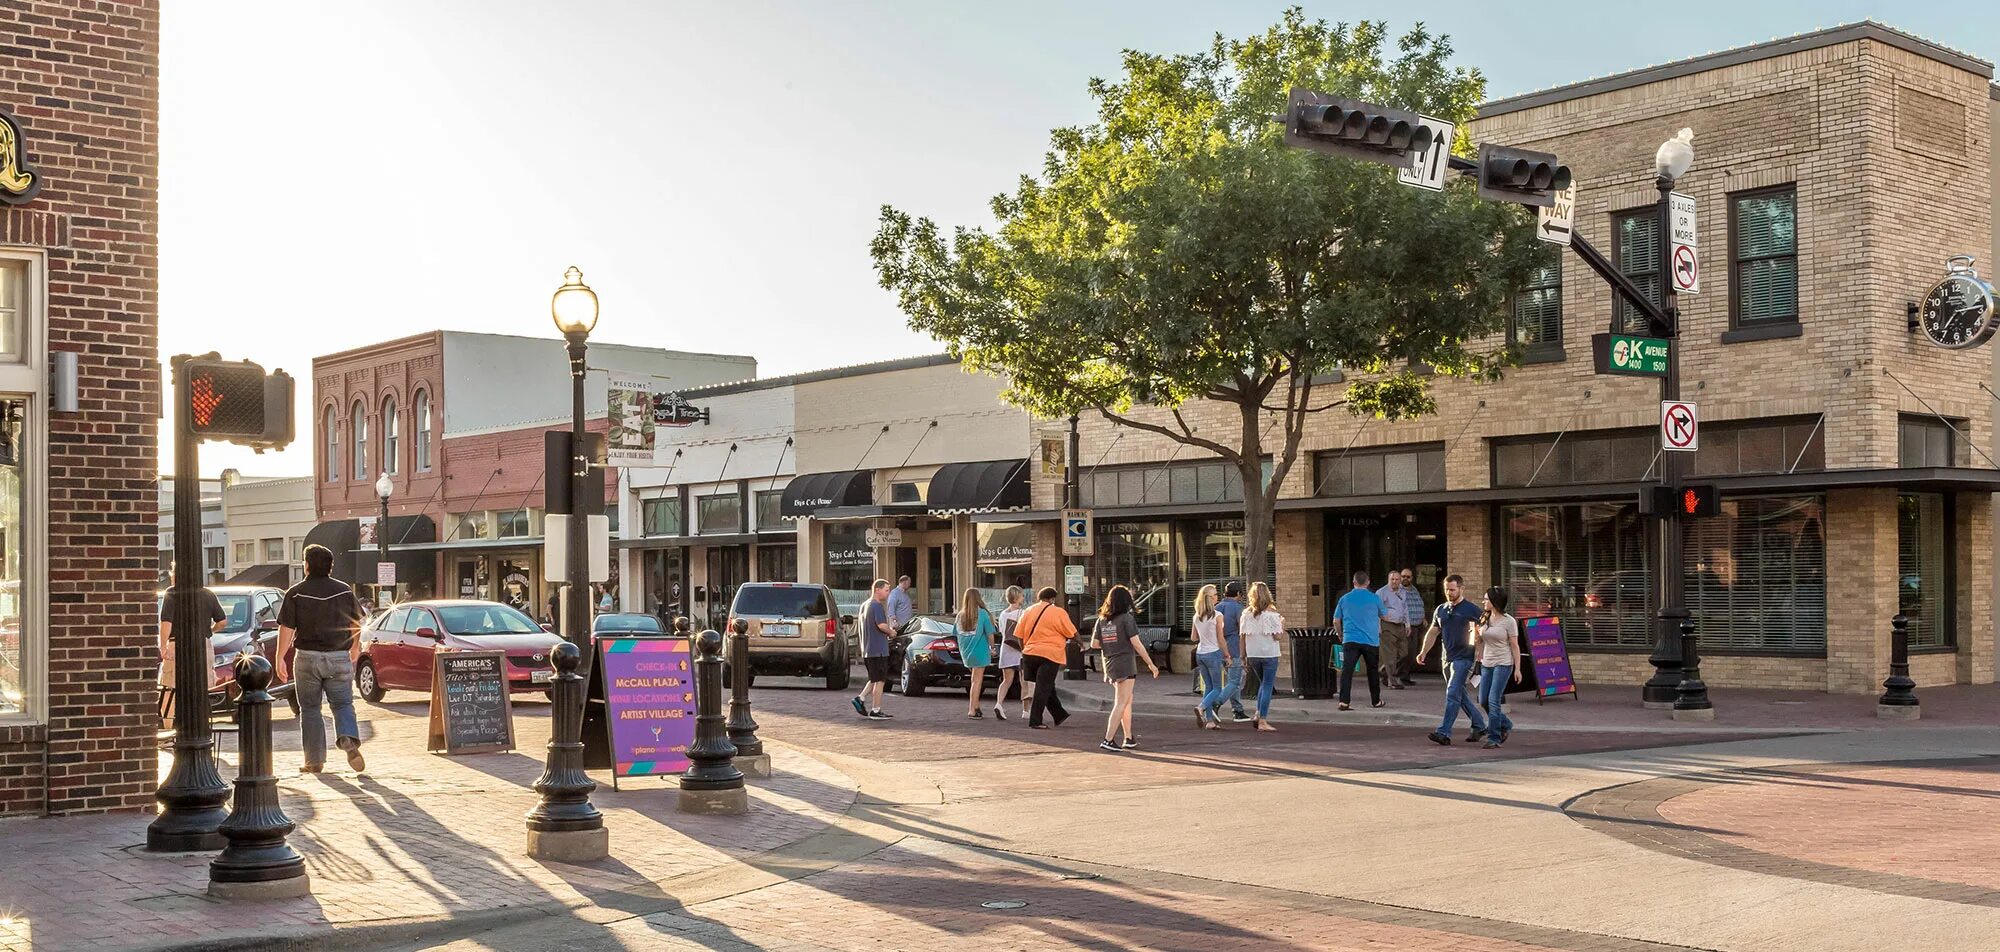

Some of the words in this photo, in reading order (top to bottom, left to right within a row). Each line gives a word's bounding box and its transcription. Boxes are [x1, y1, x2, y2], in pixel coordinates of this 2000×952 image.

[1556, 185, 1573, 201] NE
[1671, 200, 1675, 210] 3
[1677, 202, 1694, 214] AXLES
[1544, 204, 1570, 220] WAY
[1679, 216, 1688, 226] OR
[1675, 229, 1693, 241] MORE
[1952, 284, 1961, 292] 12
[1941, 289, 1948, 297] 11
[1931, 298, 1941, 306] 10
[1974, 294, 1980, 302] 2
[1929, 310, 1936, 318] 9
[1933, 322, 1939, 330] 8
[1941, 330, 1947, 338] 7
[1953, 332, 1960, 340] 6
[1965, 328, 1972, 336] 5
[1630, 340, 1643, 359] K
[1645, 346, 1668, 357] AVENUE
[1628, 360, 1642, 369] 1400
[1653, 361, 1666, 371] 1500
[613, 381, 647, 389] WELCOME
[1207, 519, 1245, 530] FILSO
[1341, 517, 1380, 526] FILSON
[1100, 524, 1139, 533] FILSON
[997, 546, 1011, 555] Cafe
[1012, 546, 1032, 555] Vienna
[452, 659, 492, 668] AMERICA'S
[635, 662, 677, 672] CHECK-IN
[615, 678, 651, 688] McCALL
[653, 678, 680, 687] PLAZA
[462, 693, 473, 702] DJ
[620, 710, 647, 720] ARTIST
[648, 709, 684, 719] VILLAGE
